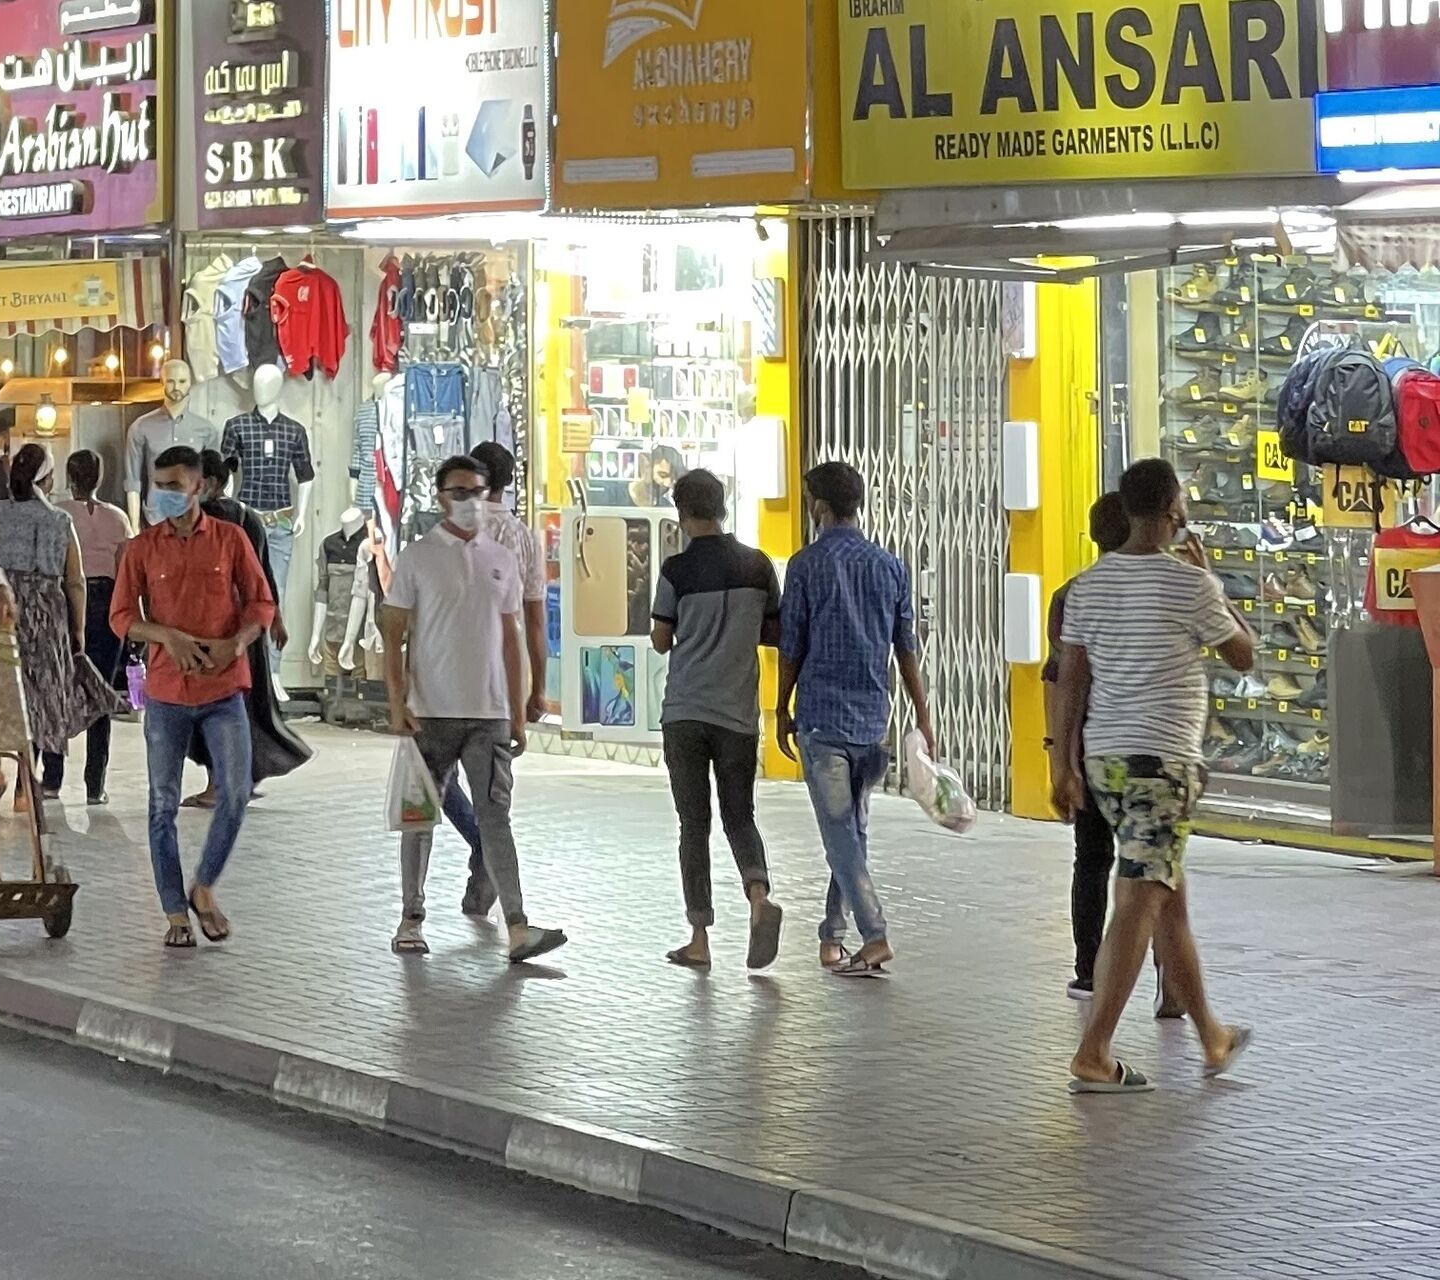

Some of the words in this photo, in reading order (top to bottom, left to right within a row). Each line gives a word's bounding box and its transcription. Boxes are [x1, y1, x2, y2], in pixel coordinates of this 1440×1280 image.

[852, 23, 954, 120] AL
[935, 132, 990, 161] READY
[997, 128, 1047, 157] MADE
[1051, 124, 1155, 154] GARMENTS
[1160, 121, 1221, 152] (L.L.C)
[1348, 420, 1370, 432] CAT
